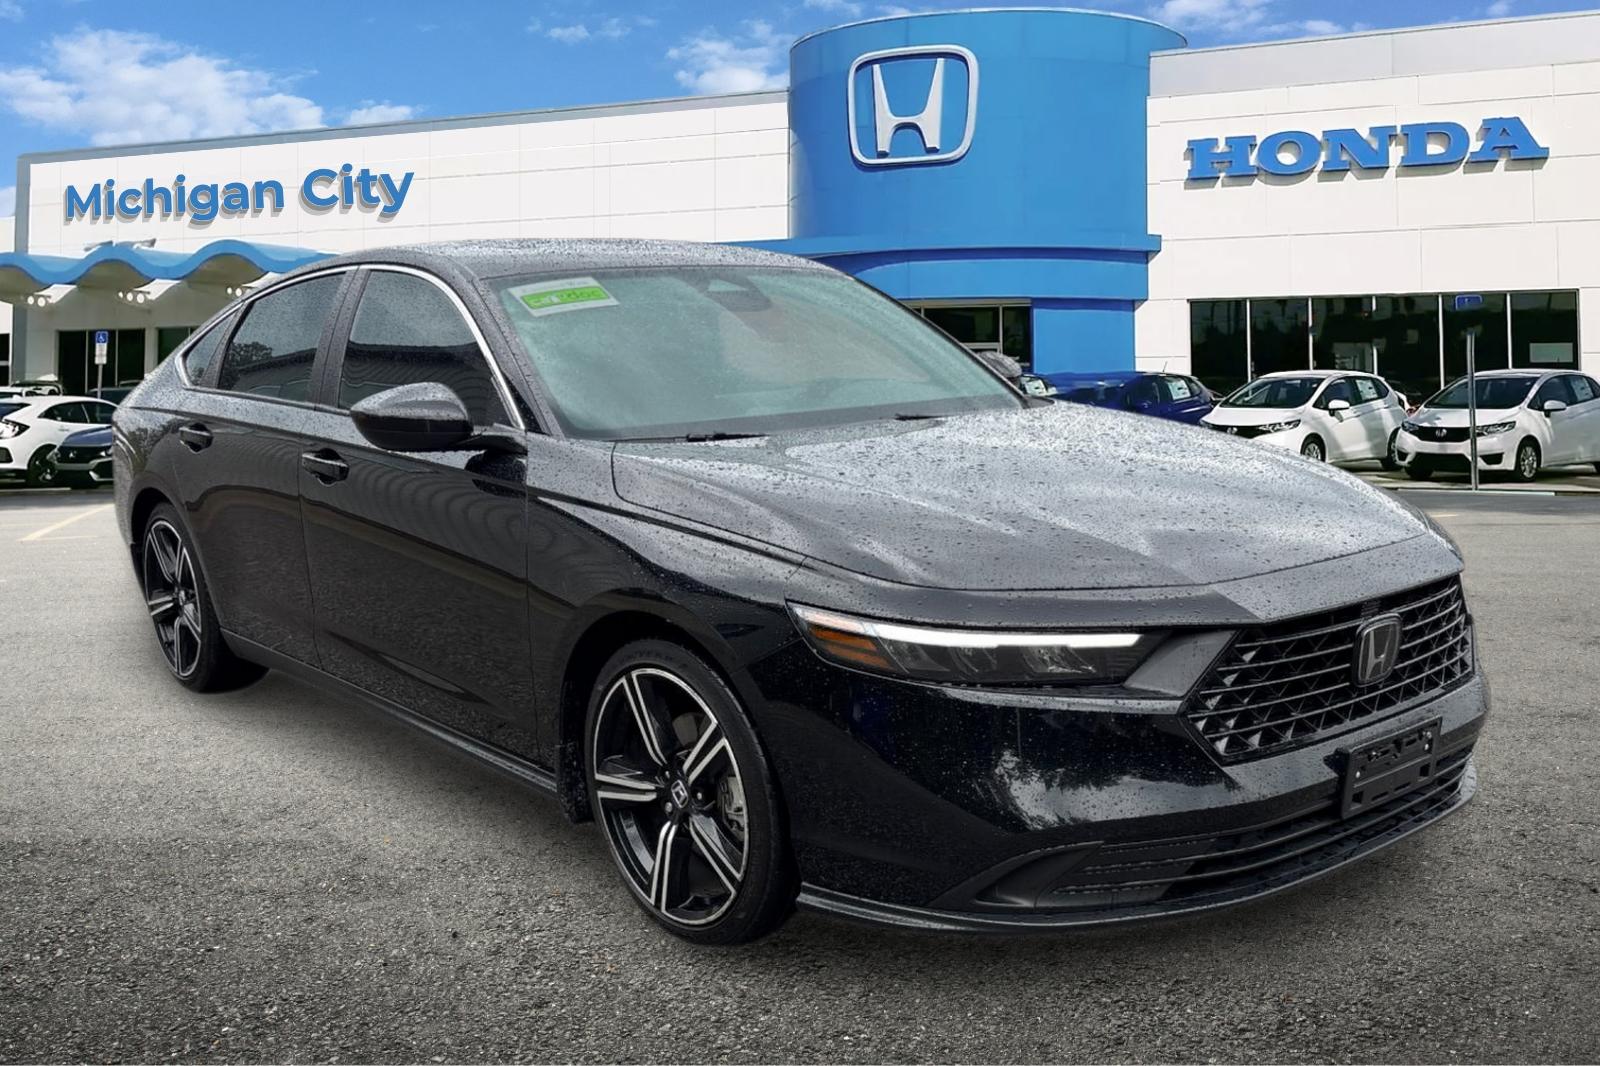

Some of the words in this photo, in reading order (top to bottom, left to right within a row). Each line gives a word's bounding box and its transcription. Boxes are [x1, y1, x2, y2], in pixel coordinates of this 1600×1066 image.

[1187, 117, 1549, 181] HONDA
[66, 174, 285, 222] Michigan
[303, 163, 415, 214] City
